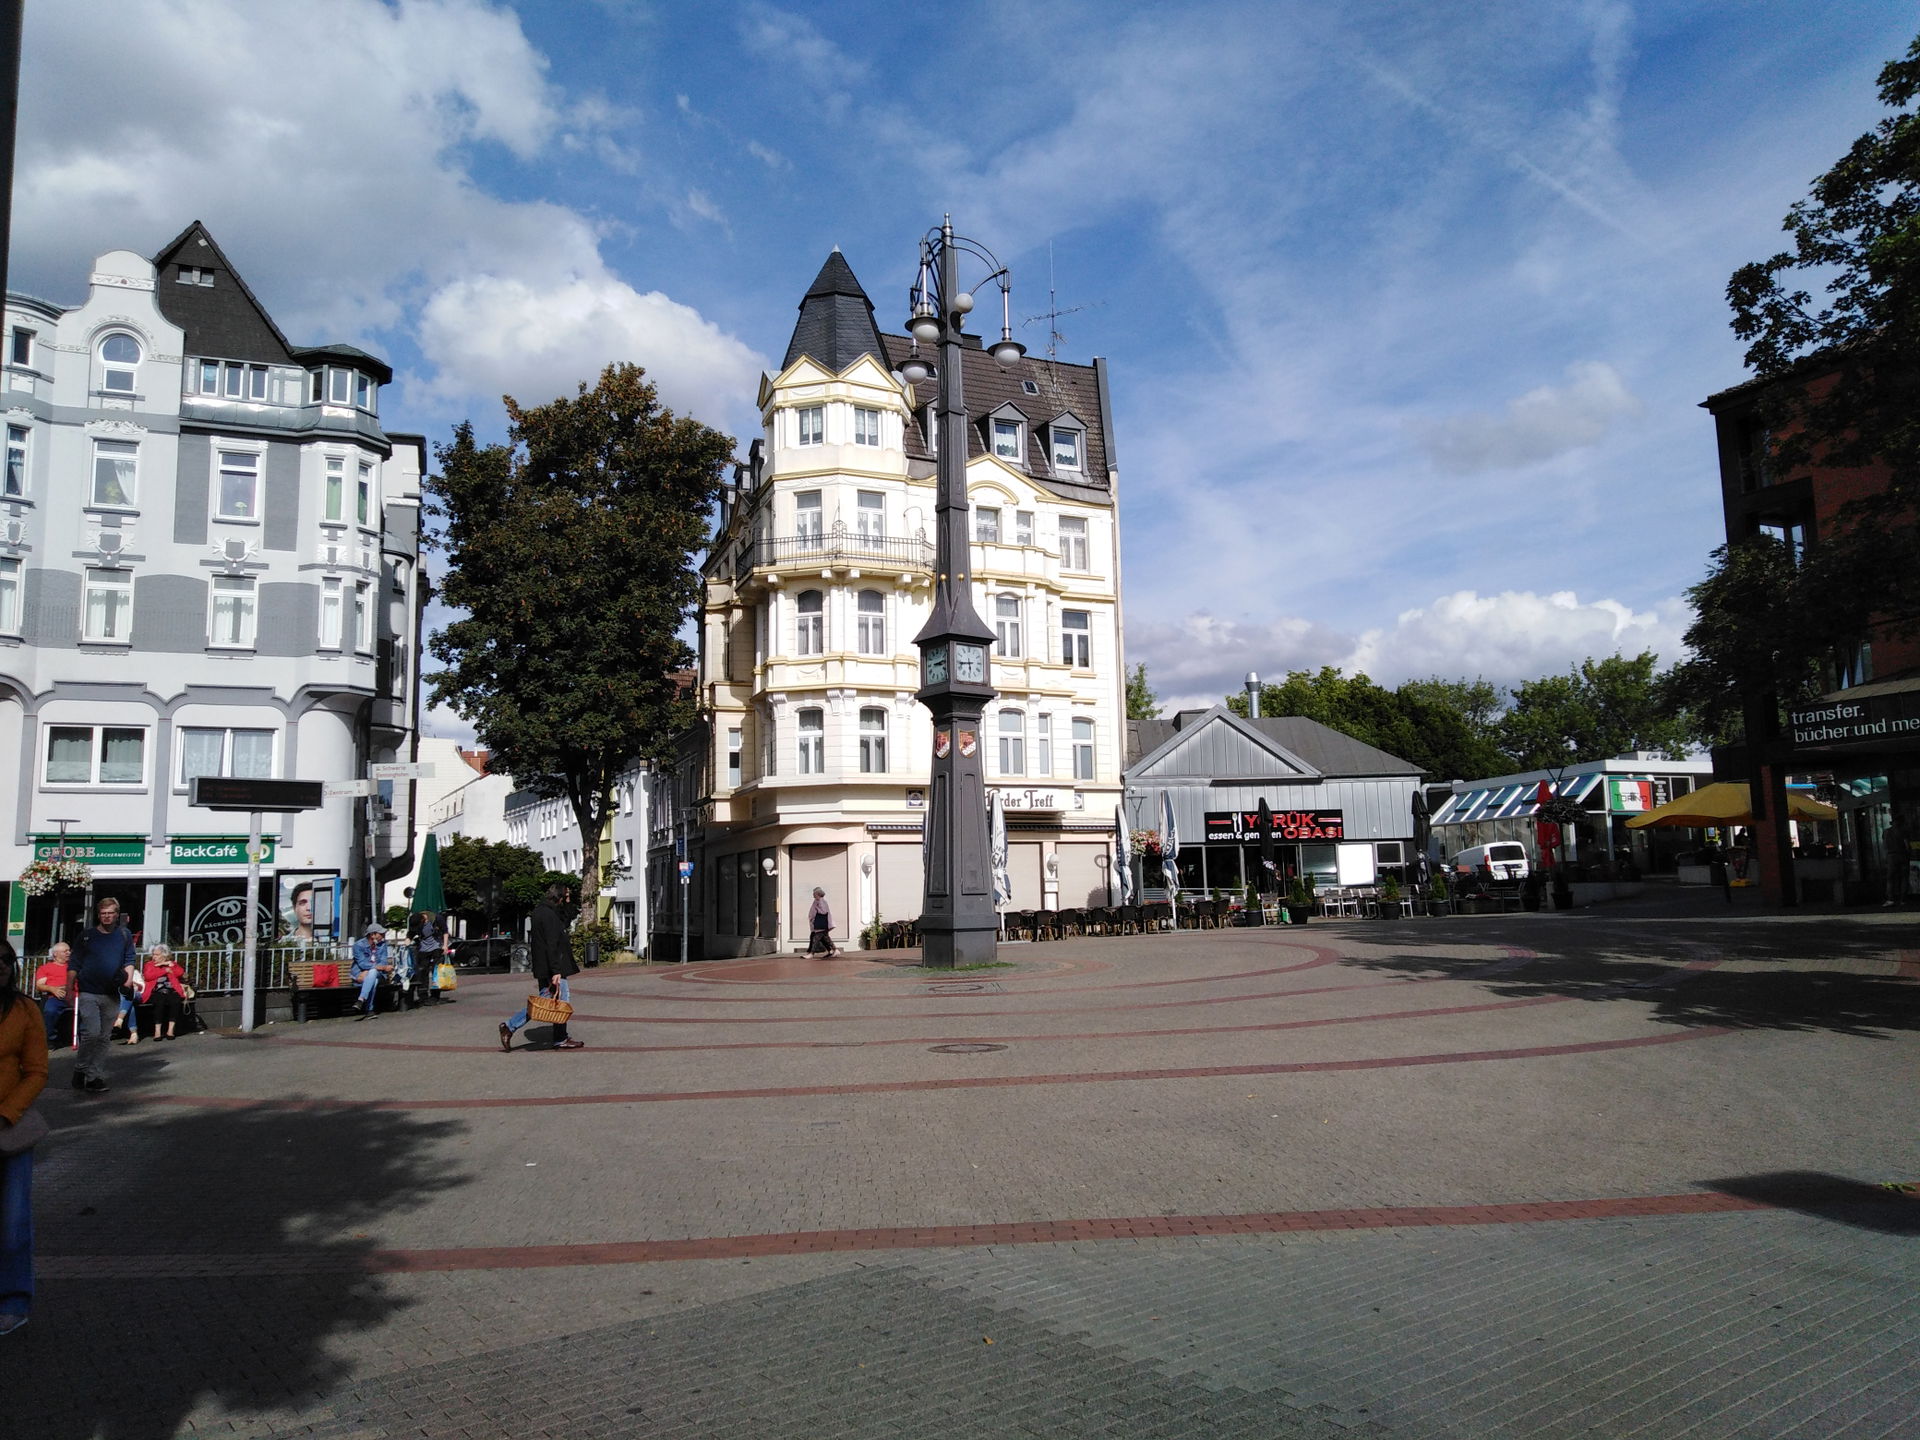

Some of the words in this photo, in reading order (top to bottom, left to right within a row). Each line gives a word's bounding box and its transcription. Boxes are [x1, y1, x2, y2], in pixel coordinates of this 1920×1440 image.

[1791, 704, 1865, 725] transfer.
[1794, 725, 1850, 743] bücher
[1854, 718, 1887, 736] und
[985, 787, 1021, 807] Hrder
[1024, 790, 1054, 809] Treff
[1244, 811, 1316, 828] YRÜK
[1208, 832, 1235, 840] essen
[1235, 830, 1243, 840] &
[1244, 831, 1282, 841] genen
[174, 845, 238, 857] BackCafé
[188, 921, 272, 947] GROE
